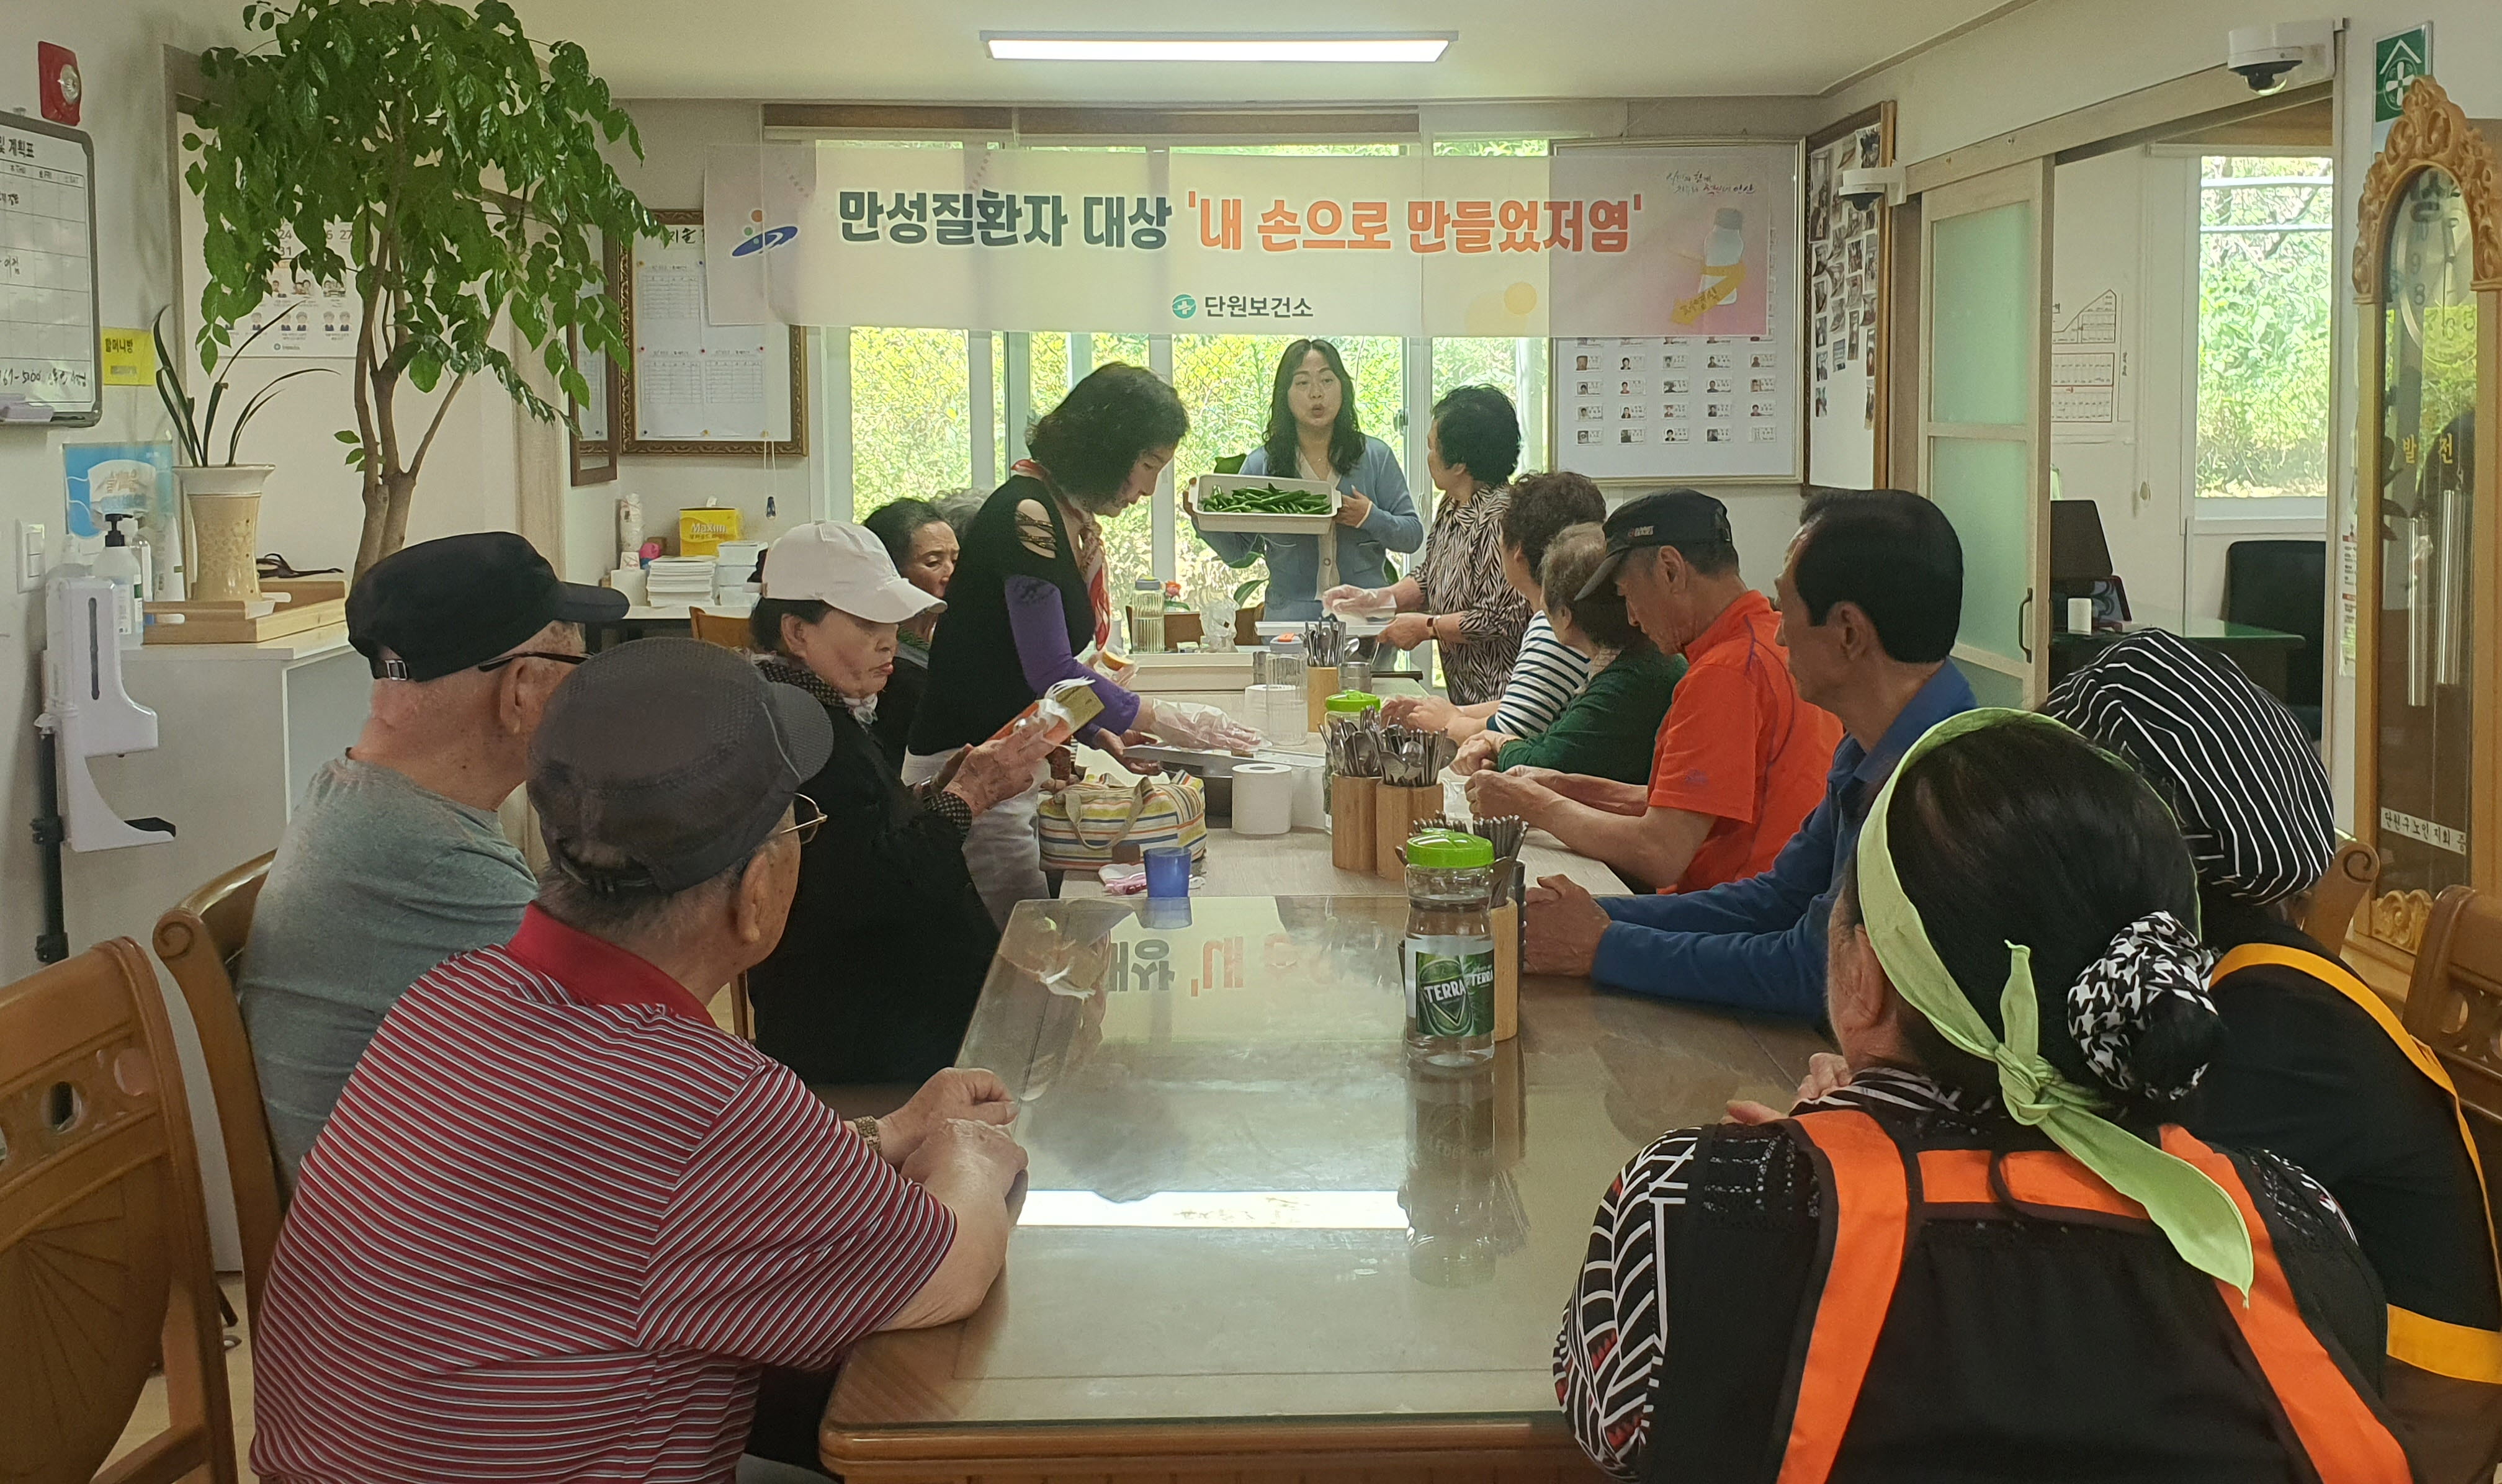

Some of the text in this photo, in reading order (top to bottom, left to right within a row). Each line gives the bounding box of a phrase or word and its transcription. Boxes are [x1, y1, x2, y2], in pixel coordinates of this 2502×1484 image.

[9, 138, 35, 158] 계획표
[839, 188, 1641, 254] 만성질환자 대상 '내 손으로 만들었저염'
[1205, 295, 1314, 318] 단원보건소
[105, 338, 133, 354] 할머니방
[691, 522, 727, 533] Maxim
[1471, 968, 1494, 986] TERRA
[1424, 978, 1467, 1003] TERRA
